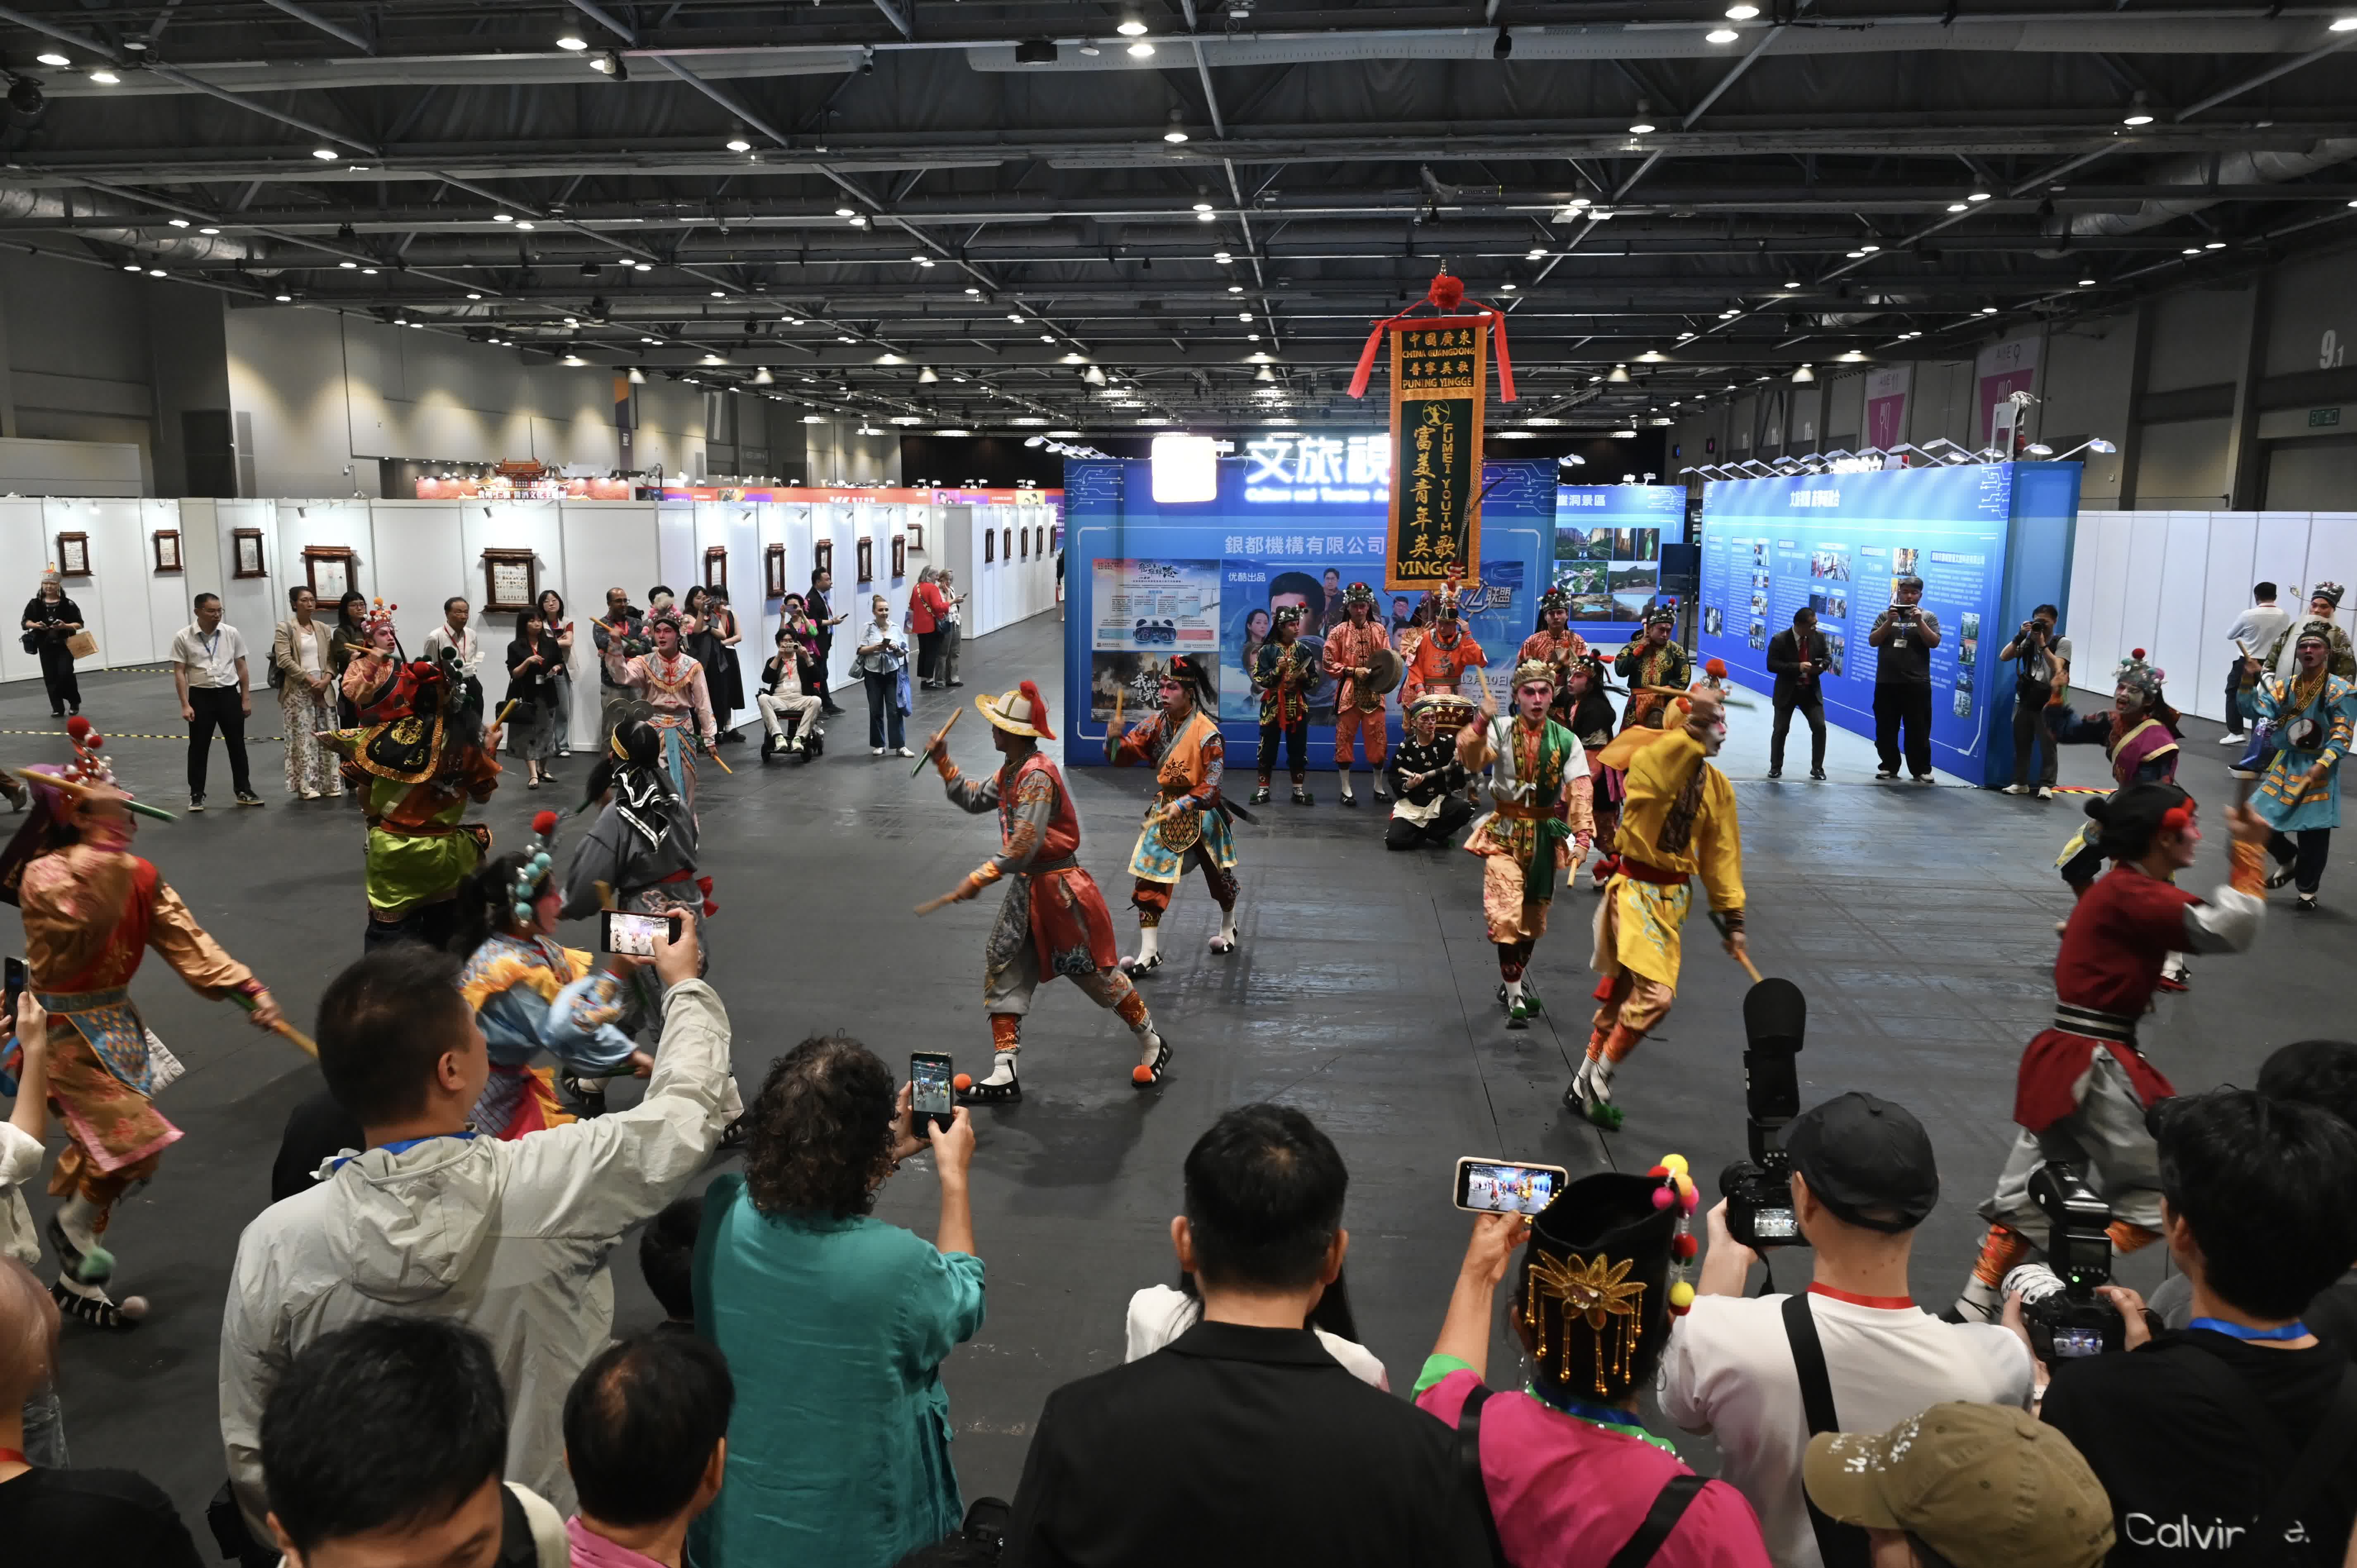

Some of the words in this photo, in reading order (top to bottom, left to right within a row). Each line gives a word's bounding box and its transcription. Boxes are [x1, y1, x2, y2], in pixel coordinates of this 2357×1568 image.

[1409, 329, 1472, 348] 中國廣東
[1402, 350, 1426, 358] CHINA
[1428, 347, 1475, 357] GUANGDONG
[1409, 361, 1469, 376] 普寧英歌
[1402, 378, 1437, 389] PUNING
[1439, 377, 1472, 387] YINGGE
[1442, 423, 1454, 474] FUMEI
[1441, 479, 1452, 531] YOUTH
[1225, 536, 1385, 555] 銀都機構有限公司
[1228, 572, 1266, 582] 优酷出品
